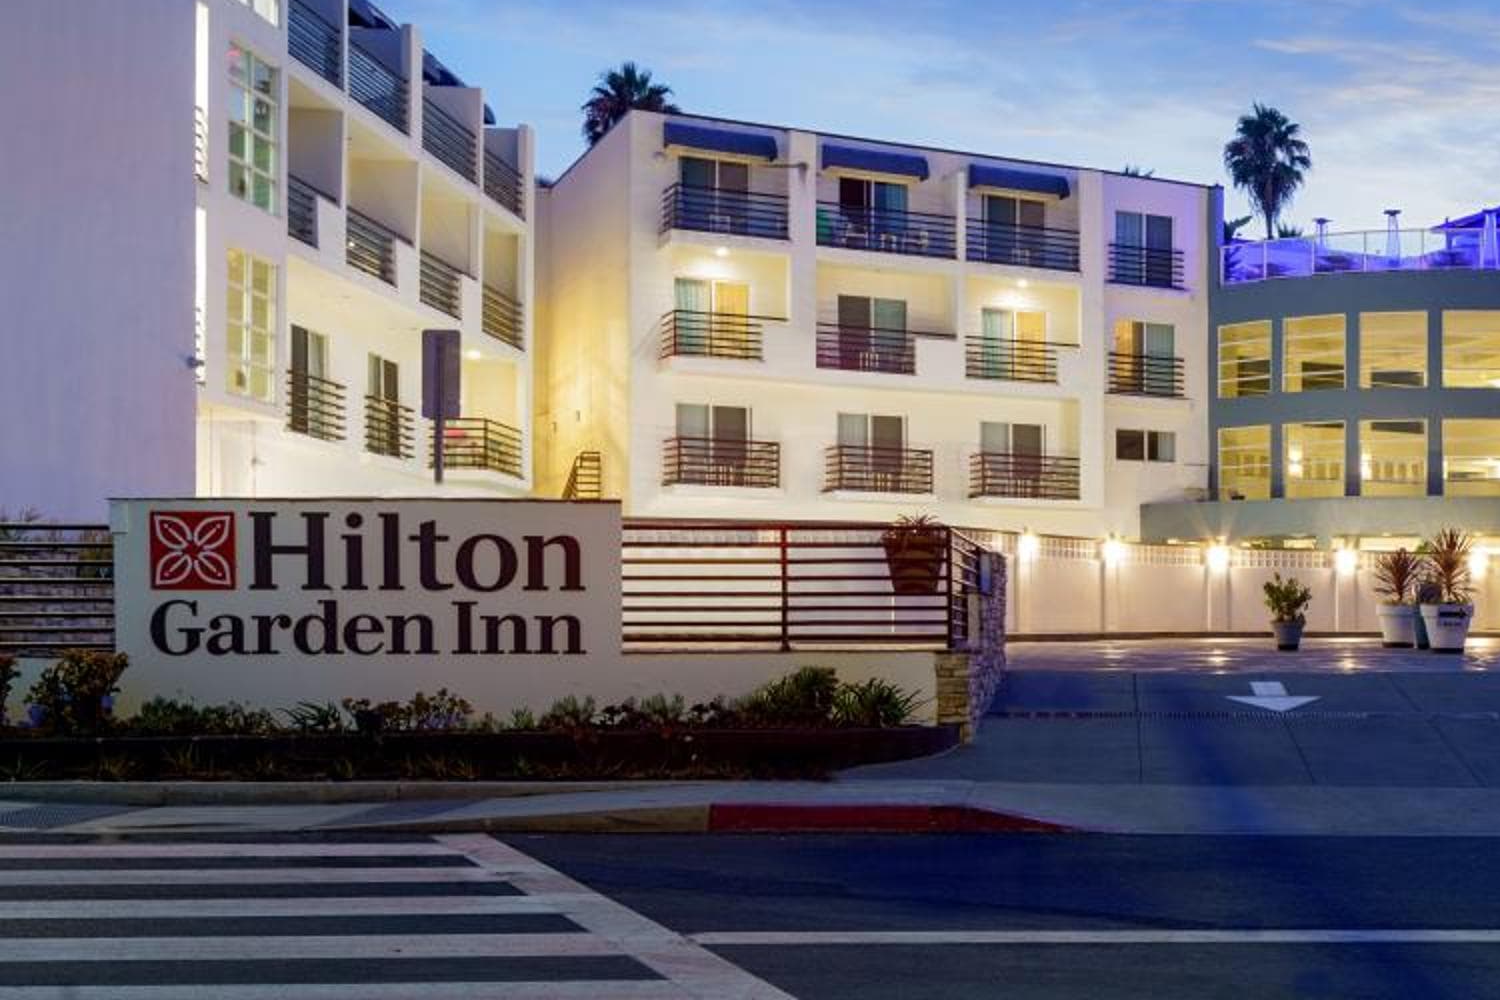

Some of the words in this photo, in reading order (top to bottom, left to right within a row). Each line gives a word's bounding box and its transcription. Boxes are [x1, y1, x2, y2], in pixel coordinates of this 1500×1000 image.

[248, 510, 587, 593] Hilton
[149, 598, 441, 657] Garden
[451, 599, 587, 655] Inn
